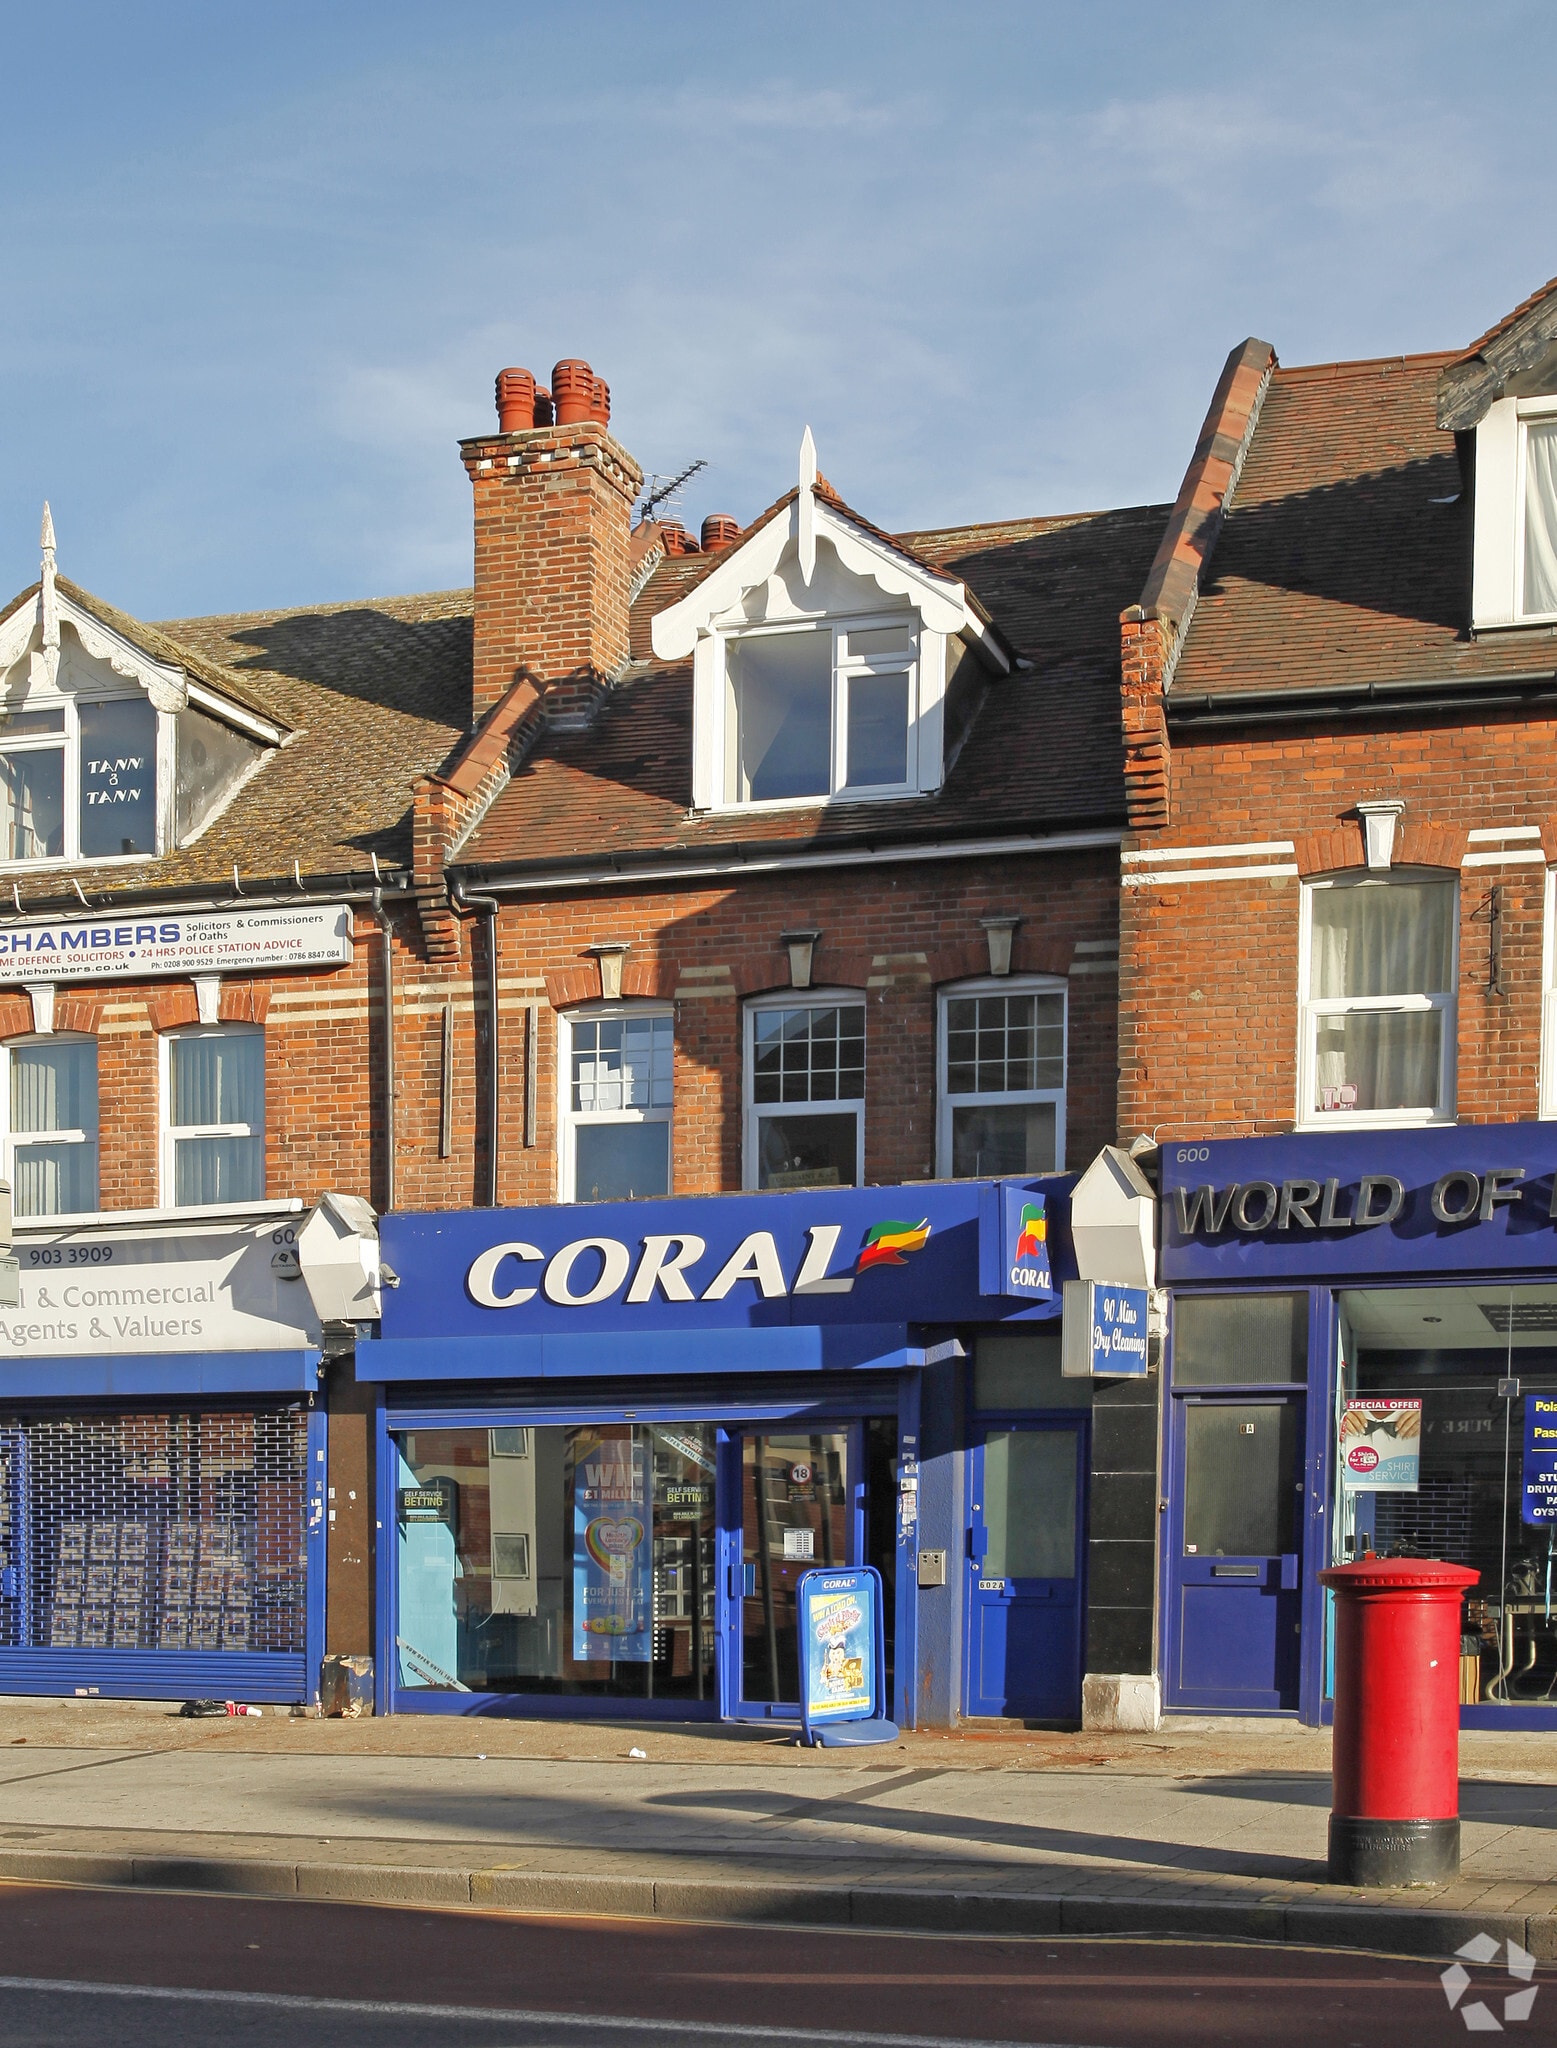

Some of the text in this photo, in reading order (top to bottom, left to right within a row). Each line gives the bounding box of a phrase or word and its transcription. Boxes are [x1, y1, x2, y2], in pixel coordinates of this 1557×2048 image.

[88, 758, 142, 774] TANN
[86, 789, 141, 804] TANN
[186, 914, 324, 932] Solicitors & Commissioners
[186, 931, 228, 942] of Oaths
[18, 954, 62, 966] DEFENCE
[67, 950, 125, 962] SOLICITORS
[140, 949, 152, 958] 24
[156, 947, 176, 957] HRS
[179, 945, 214, 955] POLICE
[218, 942, 260, 952] STATION
[264, 938, 302, 950] ADVICE
[1, 962, 130, 977] w.slchambers.co.uk
[152, 962, 162, 970] Ph:
[216, 956, 254, 966] Emergency
[256, 955, 284, 963] number
[308, 951, 324, 959] 8847
[327, 950, 340, 958] 084
[1176, 1148, 1210, 1162] 600
[1173, 1175, 1404, 1234] WORLD
[1431, 1168, 1526, 1222] OF
[30, 1246, 113, 1264] 903 3909
[468, 1225, 854, 1308] CORAL
[1010, 1266, 1050, 1288] CORAL
[38, 1282, 215, 1308] & Commercial
[1104, 1298, 1137, 1324] 90 Mins
[89, 1317, 112, 1338] &
[113, 1316, 202, 1338] Valuers
[1094, 1326, 1146, 1360] Dry Cleaning
[1534, 1427, 1557, 1438] Pas
[794, 1468, 808, 1478] 18
[1387, 1462, 1416, 1471] SHIRT
[1369, 1471, 1416, 1481] SERVICE
[404, 1497, 443, 1506] BETTING
[667, 1493, 710, 1502] BETTING
[584, 1587, 604, 1596] FOR
[823, 1580, 852, 1588] CORAL
